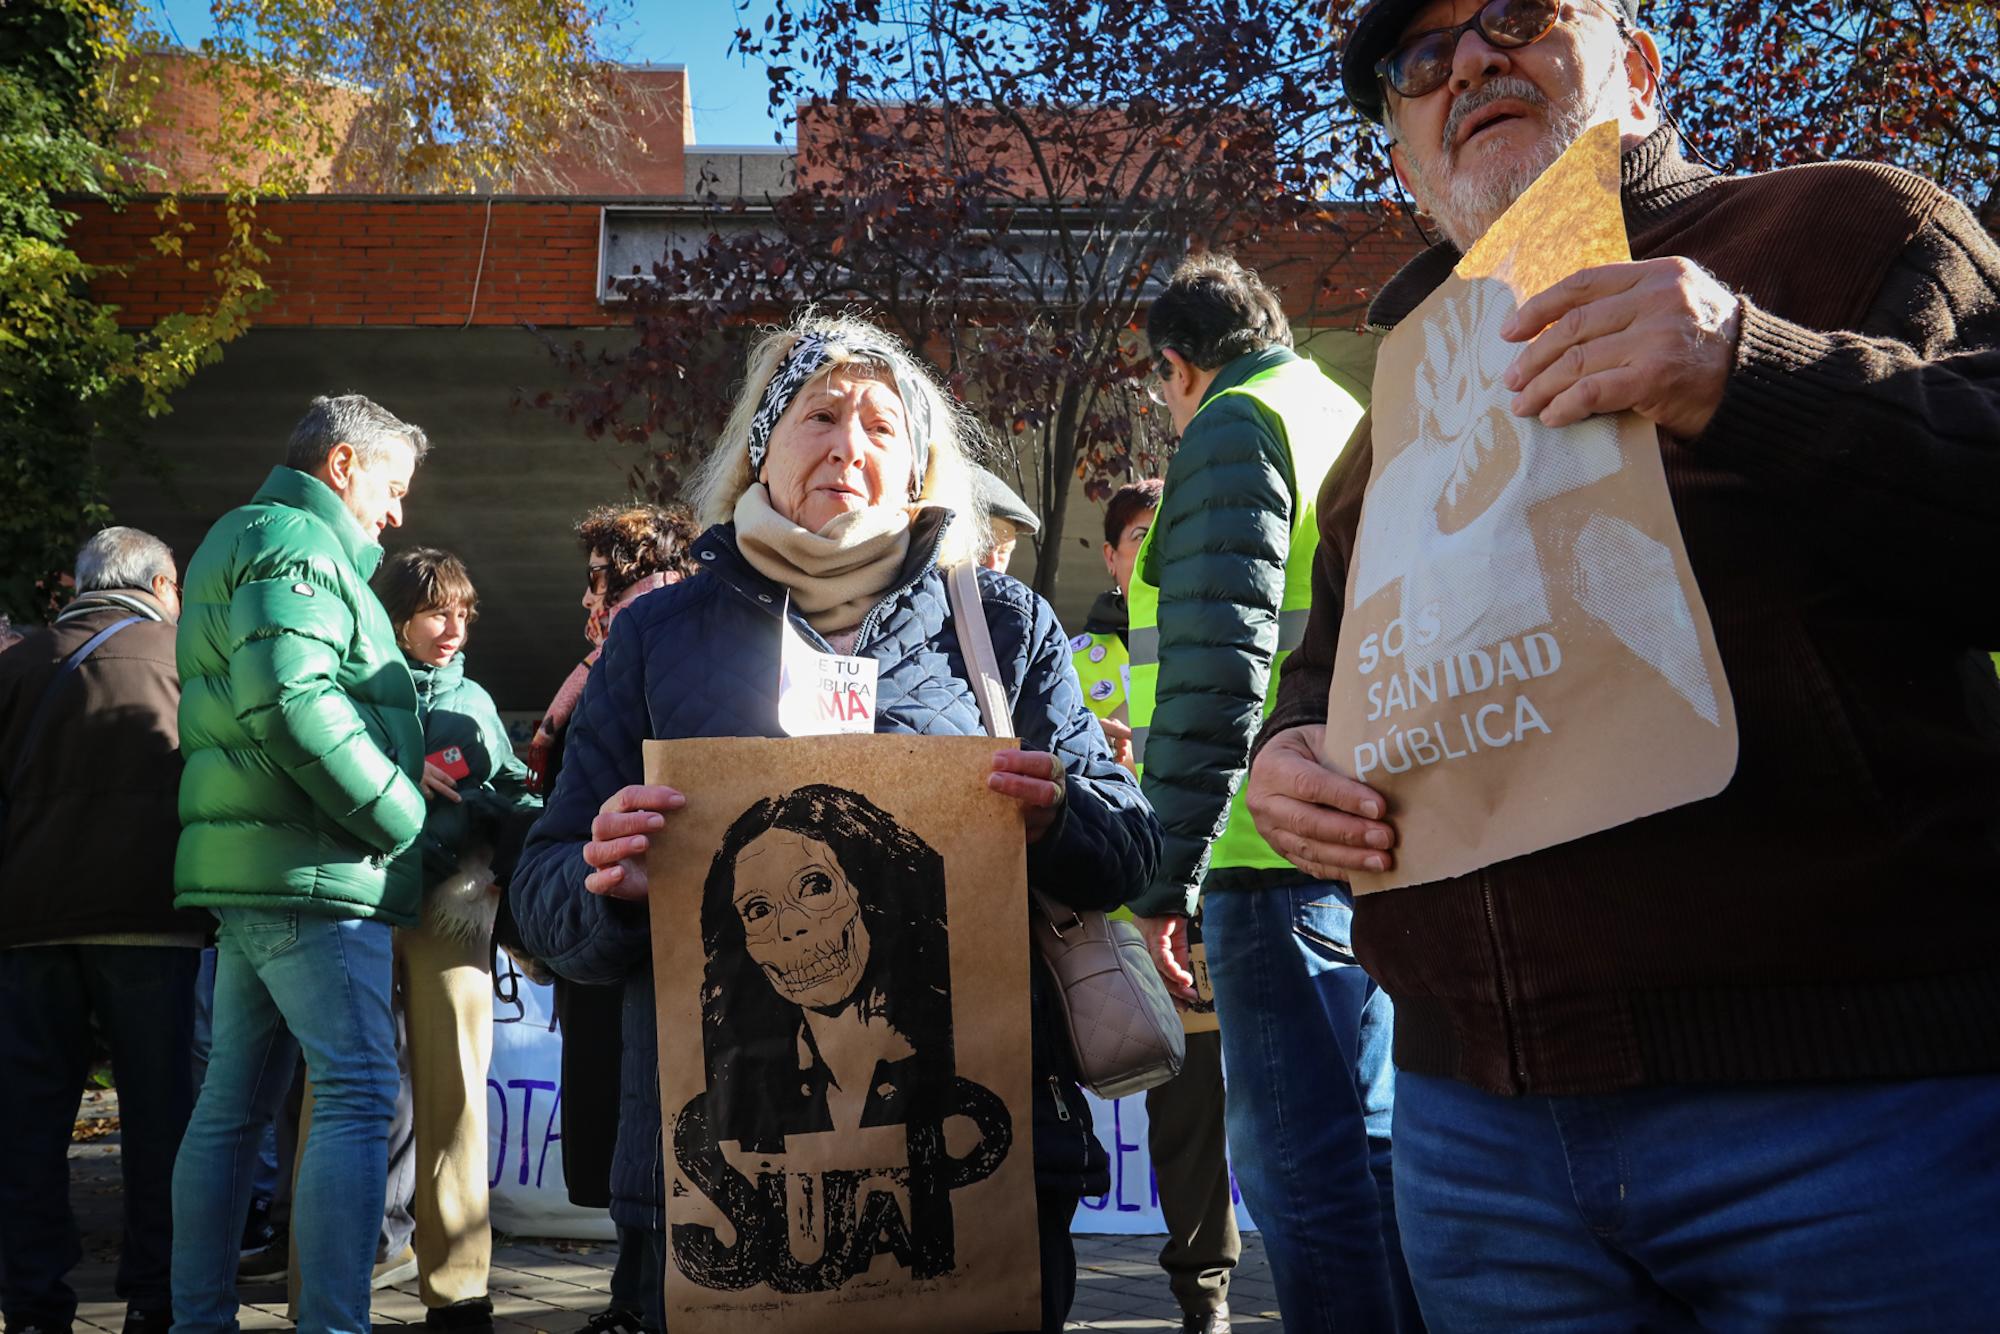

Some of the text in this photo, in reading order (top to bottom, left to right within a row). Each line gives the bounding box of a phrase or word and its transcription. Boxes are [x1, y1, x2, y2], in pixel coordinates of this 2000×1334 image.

[834, 661, 860, 675] TU
[1358, 603, 1441, 674] SOS
[816, 689, 870, 721] MA
[1367, 632, 1562, 721] SANIDAD
[1354, 695, 1552, 783] PÚBLICA
